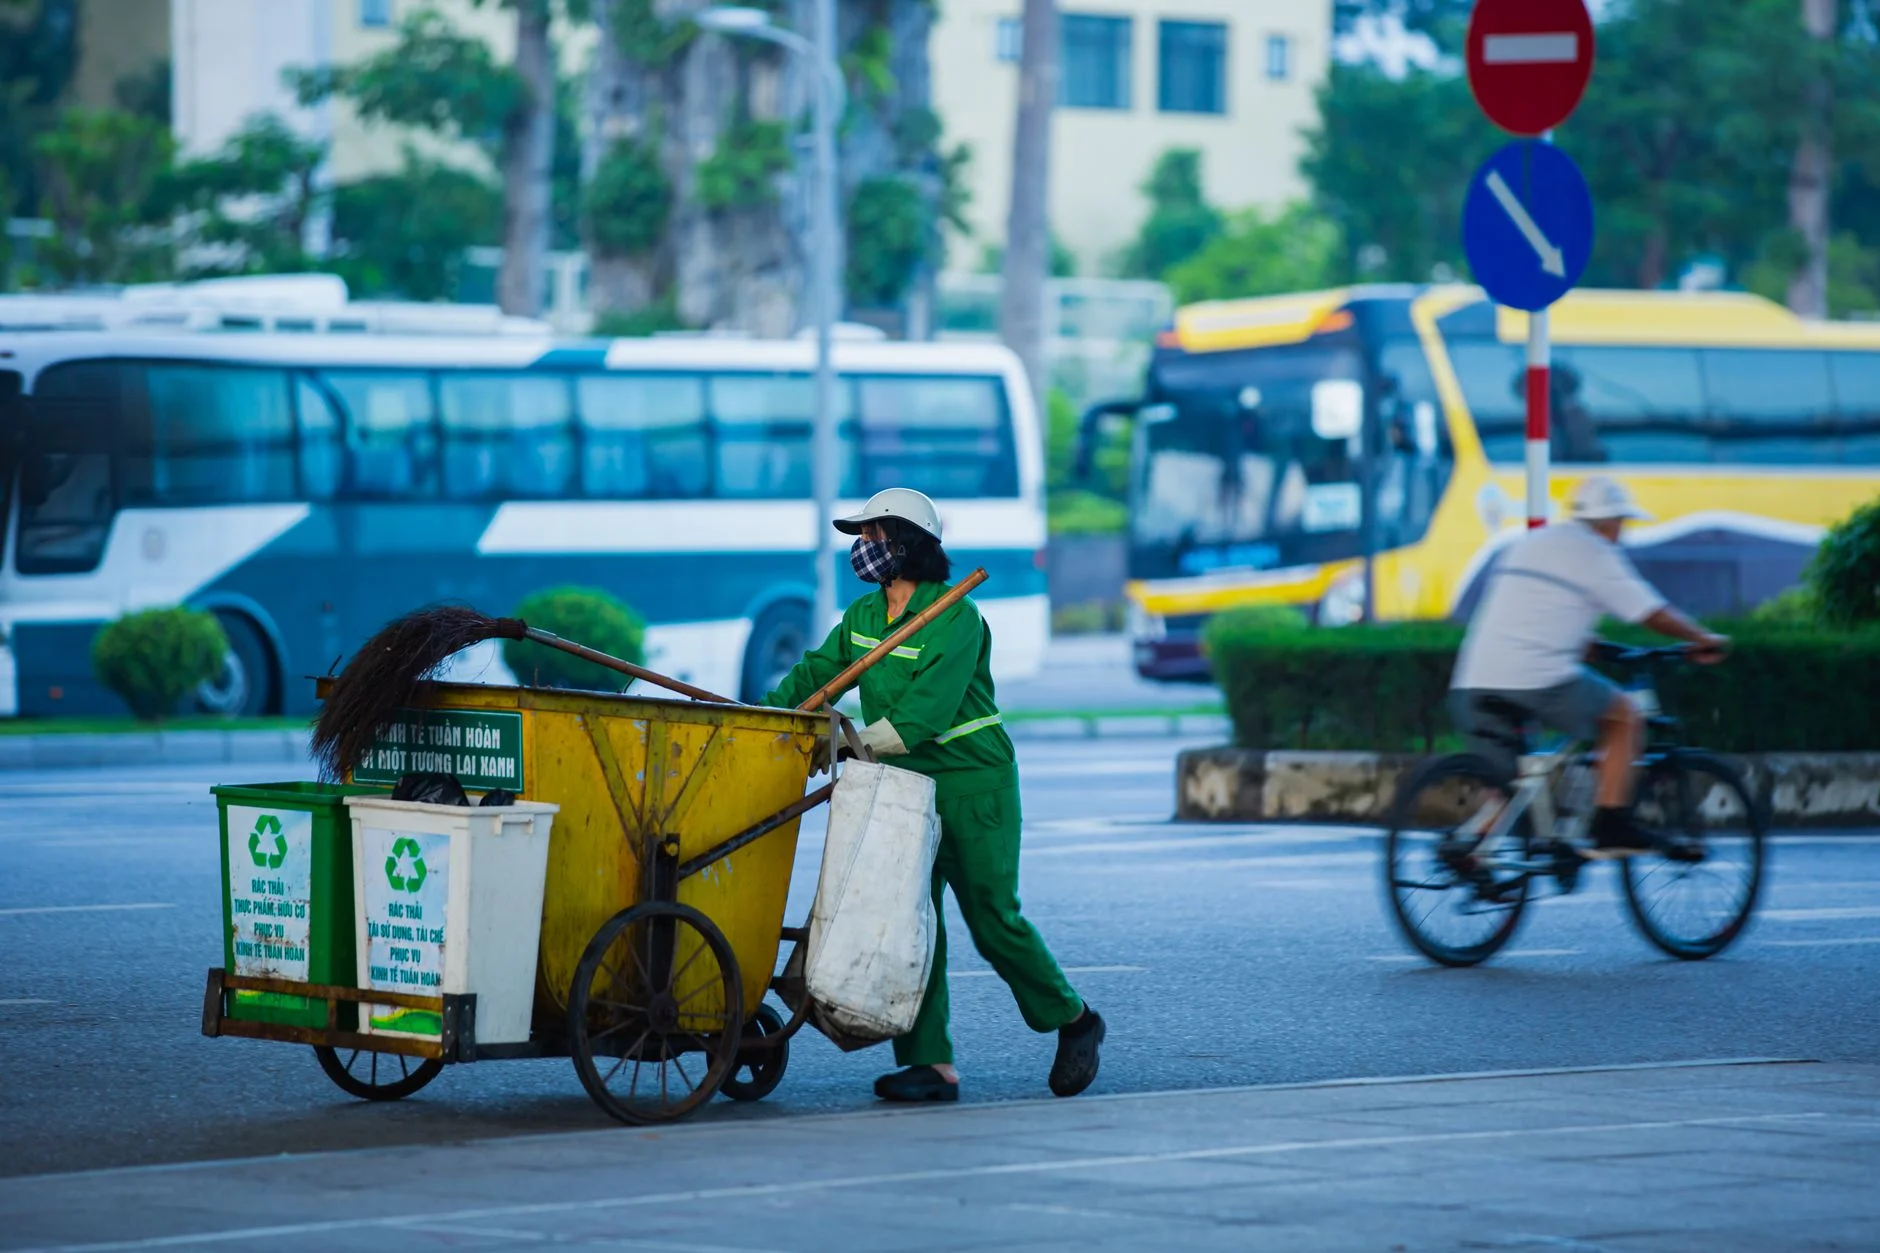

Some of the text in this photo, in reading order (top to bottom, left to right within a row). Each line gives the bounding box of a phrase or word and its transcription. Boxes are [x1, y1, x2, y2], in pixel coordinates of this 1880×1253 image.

[378, 746, 407, 774] MỘT
[411, 750, 452, 774] TƯƠNG
[456, 755, 476, 775] LAI
[480, 756, 515, 778] XANH
[252, 876, 284, 896] RÁC THẢI
[234, 898, 251, 916] THỰC
[295, 904, 305, 918] CƠ
[388, 901, 422, 920] RÁC THẢI
[236, 941, 252, 957] KINH
[390, 947, 421, 966] PHỤC VỤ
[371, 966, 388, 982] KINH
[390, 965, 398, 983] TẾ
